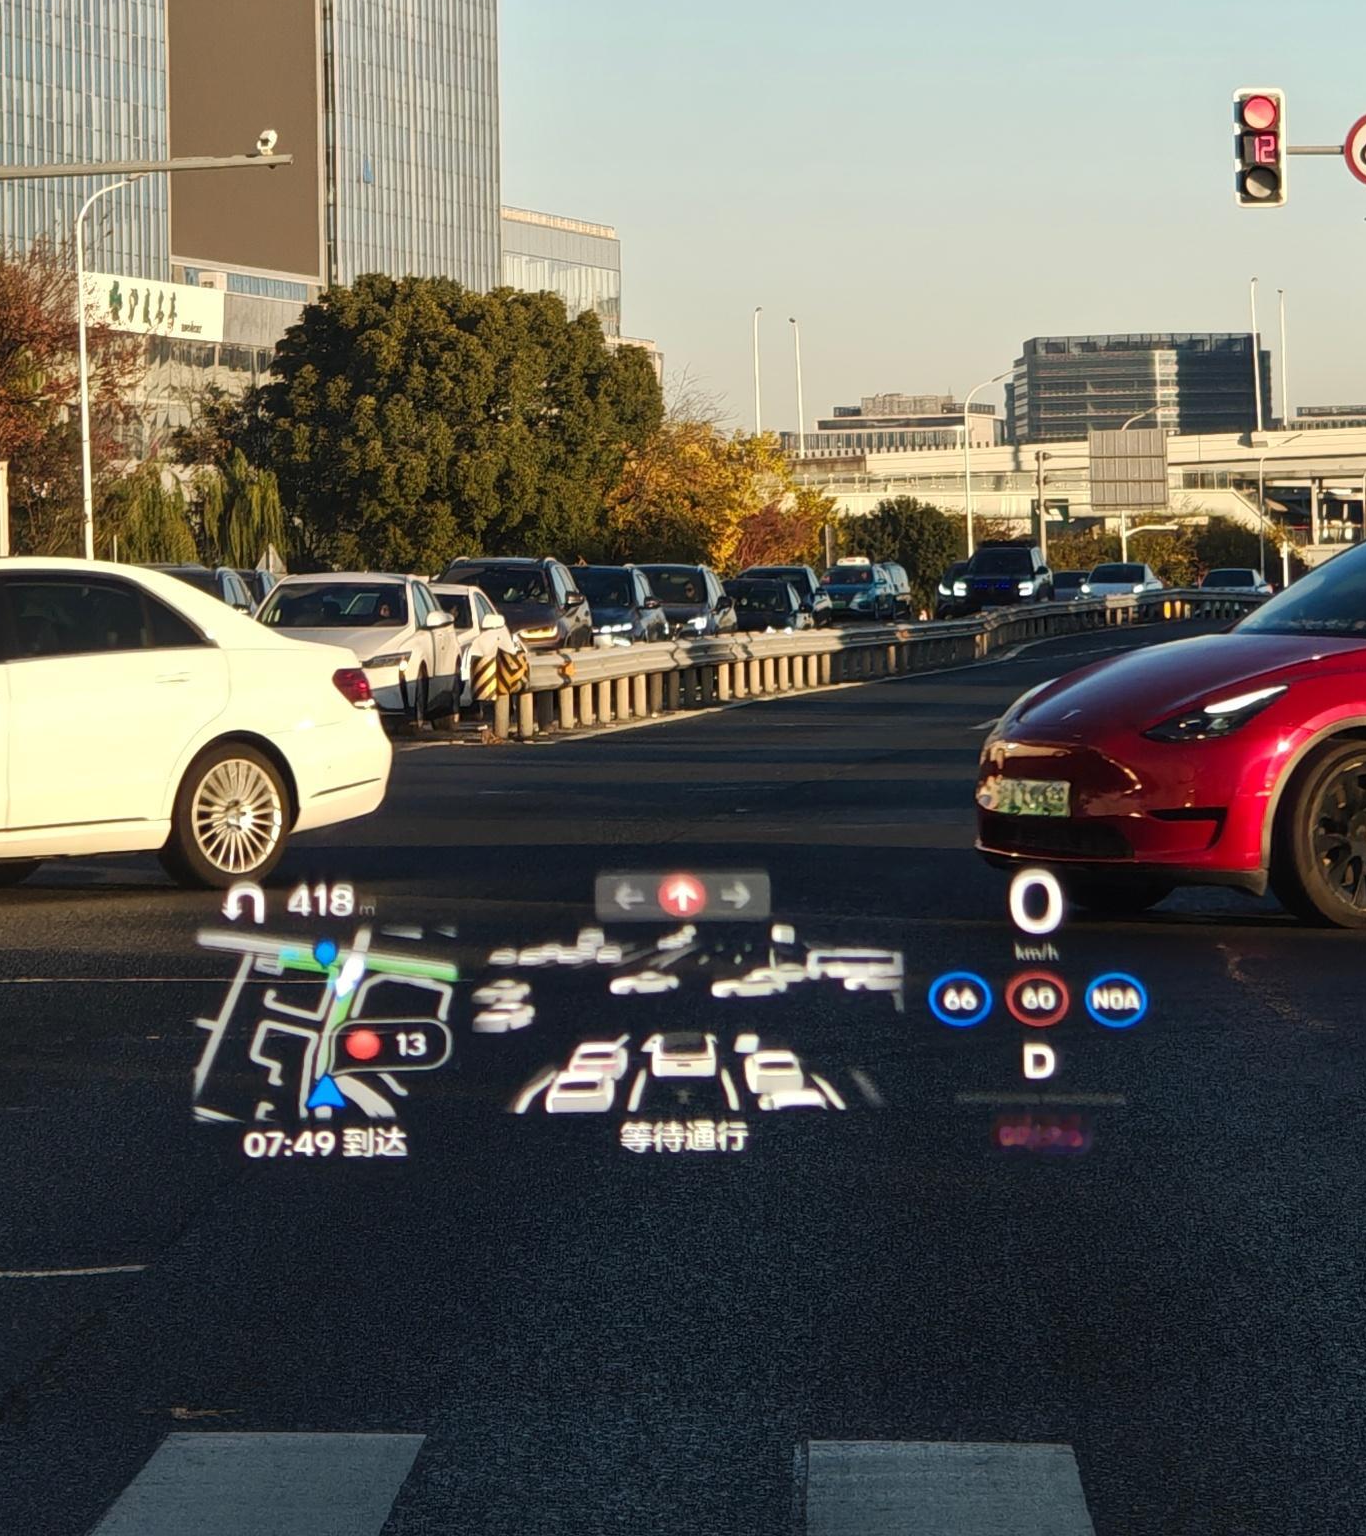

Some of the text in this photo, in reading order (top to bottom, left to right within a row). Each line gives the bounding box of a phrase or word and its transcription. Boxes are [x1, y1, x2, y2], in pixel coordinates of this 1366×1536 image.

[1253, 134, 1277, 163] 12
[287, 884, 376, 917] 418 m
[1009, 868, 1063, 934] 0
[1015, 942, 1060, 961] km/h
[943, 988, 978, 1011] 66
[1021, 988, 1056, 1011] 60
[1092, 988, 1141, 1011] NOA
[395, 1033, 427, 1057] 13
[1023, 1043, 1055, 1079] D
[243, 1127, 408, 1158] 07:49 到达
[620, 1121, 749, 1153] 等待通行
